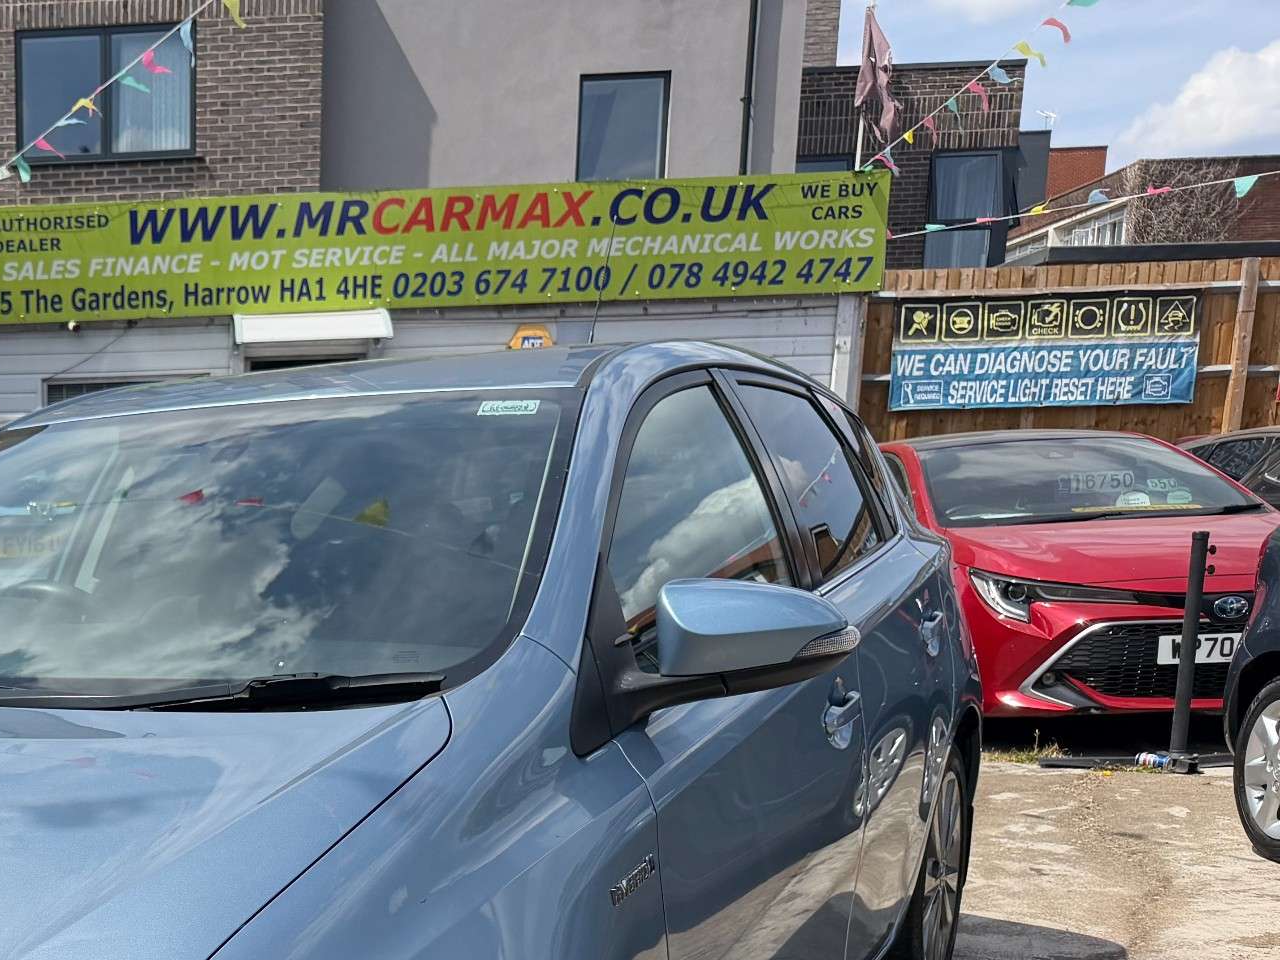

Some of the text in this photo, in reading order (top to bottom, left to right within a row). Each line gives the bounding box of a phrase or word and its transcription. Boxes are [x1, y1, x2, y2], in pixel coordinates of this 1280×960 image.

[801, 182, 878, 200] WE BUY
[128, 183, 777, 246] WWW.MRCARMAX.CO.UK
[811, 204, 863, 221] CARS
[1, 259, 81, 282] SALES
[88, 252, 203, 279] FINANCE
[228, 249, 287, 273] MOT
[292, 245, 405, 270] SERVICE
[430, 242, 477, 264] ALL
[486, 238, 579, 262] MAJOR
[586, 231, 762, 258] MECHANICAL
[774, 227, 876, 250] WORKS
[21, 289, 63, 315] The
[71, 285, 173, 313] Gardens,
[184, 282, 270, 307] Harrow
[280, 278, 325, 302] HA1
[336, 274, 383, 300] 4HE
[391, 271, 465, 298] 0203
[474, 268, 528, 295] 674
[538, 266, 611, 293] 7100
[620, 264, 637, 295] /
[647, 262, 703, 290] 078
[711, 259, 787, 287] 4942
[795, 256, 875, 284] 4747
[1032, 327, 1059, 335] CHECK
[896, 346, 1194, 376] WE CAN DIAGNOSE YOUR FAULT
[948, 376, 1135, 404] SERVICE LIGHT RESET HERE
